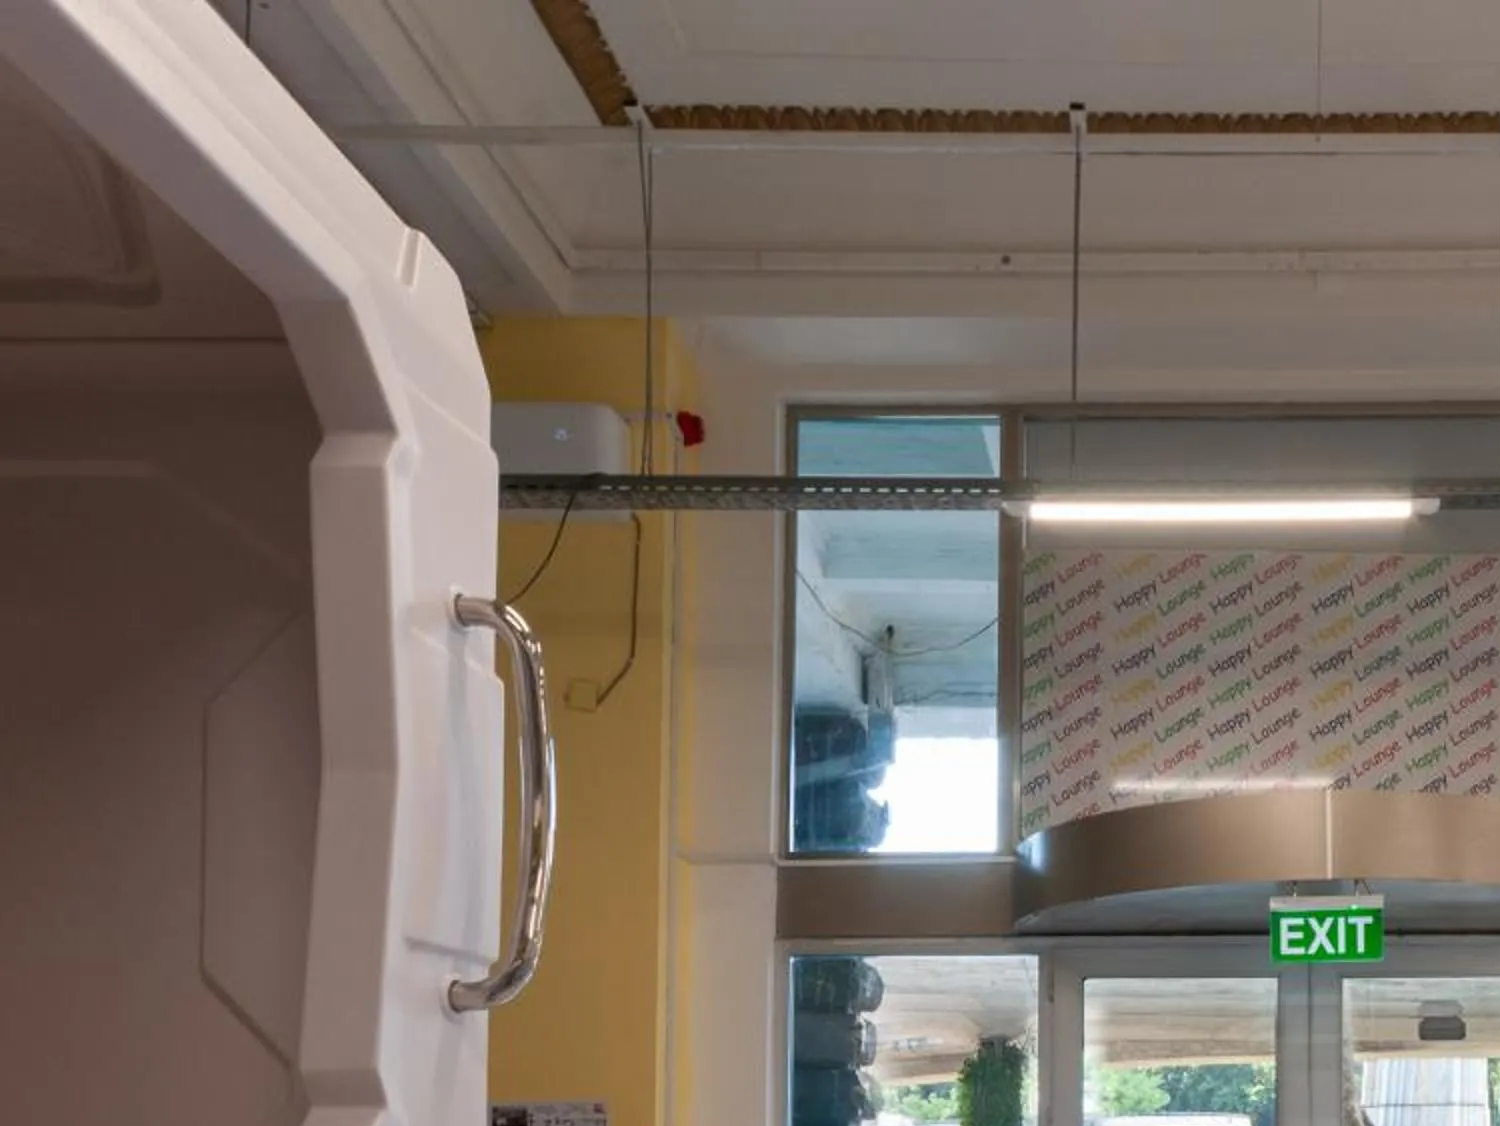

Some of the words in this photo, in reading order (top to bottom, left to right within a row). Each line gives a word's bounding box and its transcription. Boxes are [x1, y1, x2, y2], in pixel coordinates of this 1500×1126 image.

[1022, 580, 1055, 607] appy
[1022, 643, 1054, 670] appy
[1021, 705, 1053, 734] appy
[1022, 770, 1051, 797] appy
[1279, 915, 1374, 955] EXIT
